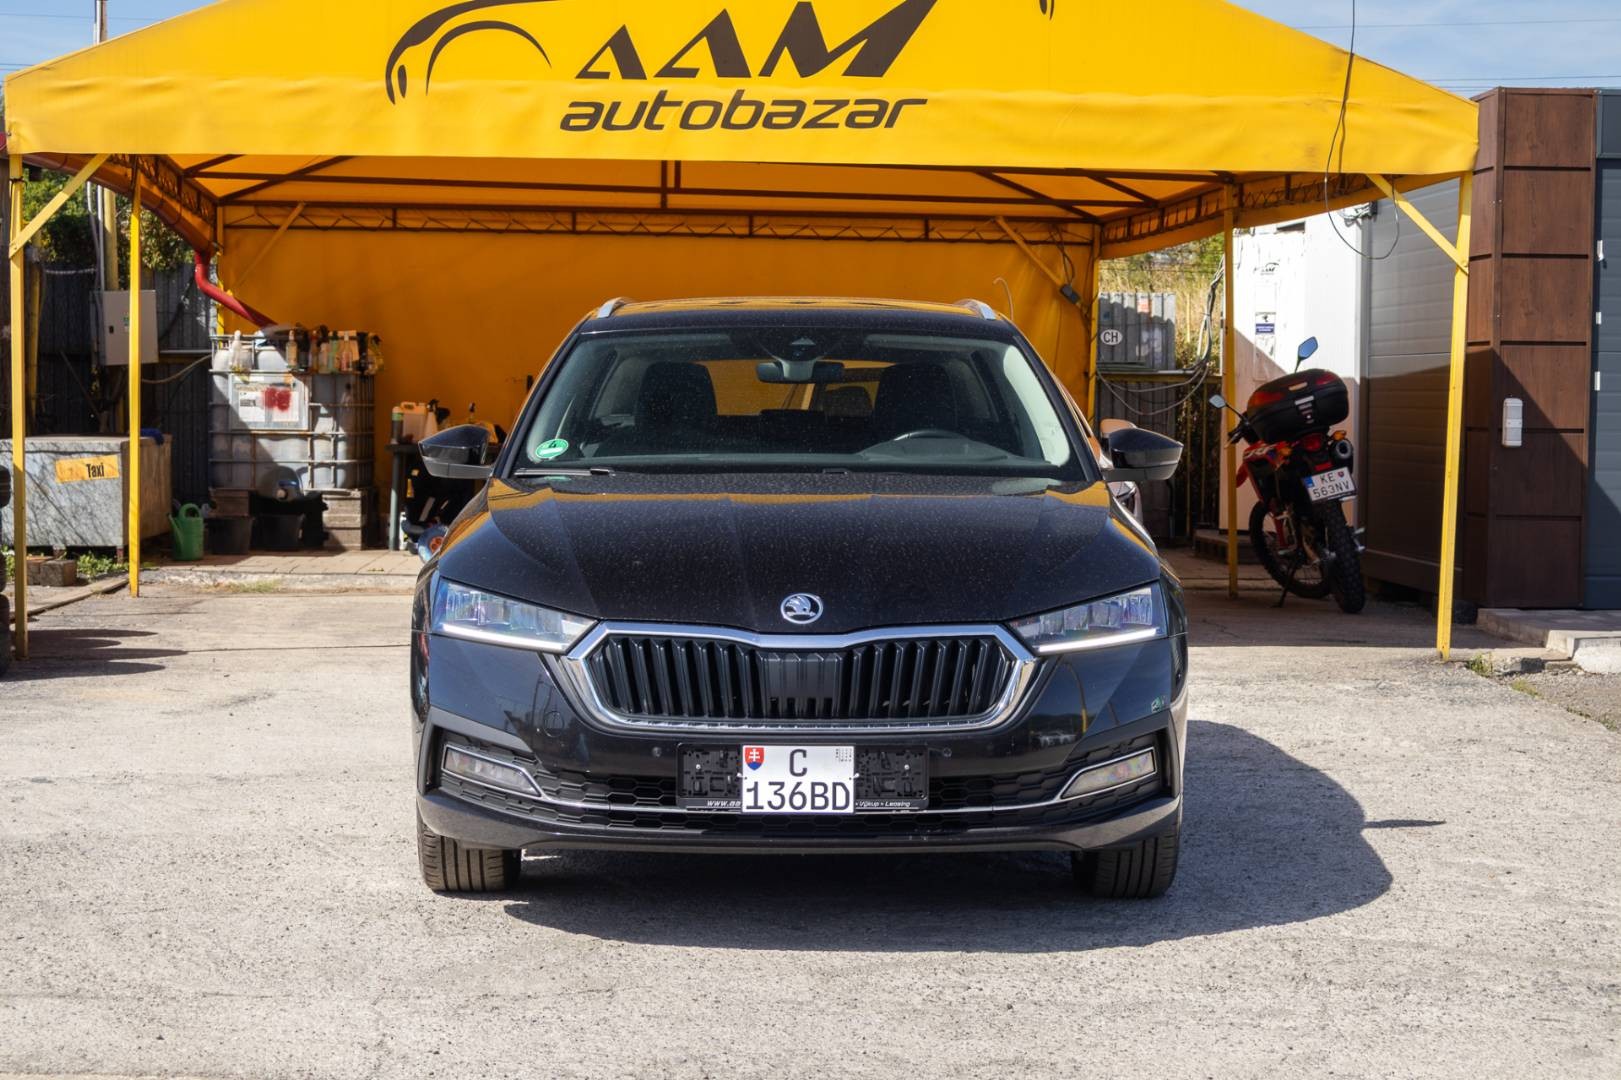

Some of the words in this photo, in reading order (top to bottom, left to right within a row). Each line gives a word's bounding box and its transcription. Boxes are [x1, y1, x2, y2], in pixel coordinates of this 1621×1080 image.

[574, 0, 937, 80] AAM
[560, 89, 928, 132] autobazar
[1103, 331, 1119, 343] CH
[86, 462, 105, 478] Taxi
[1320, 472, 1335, 484] KE
[1312, 480, 1350, 498] 563NV
[789, 749, 808, 777] C
[745, 781, 850, 810] 136BD
